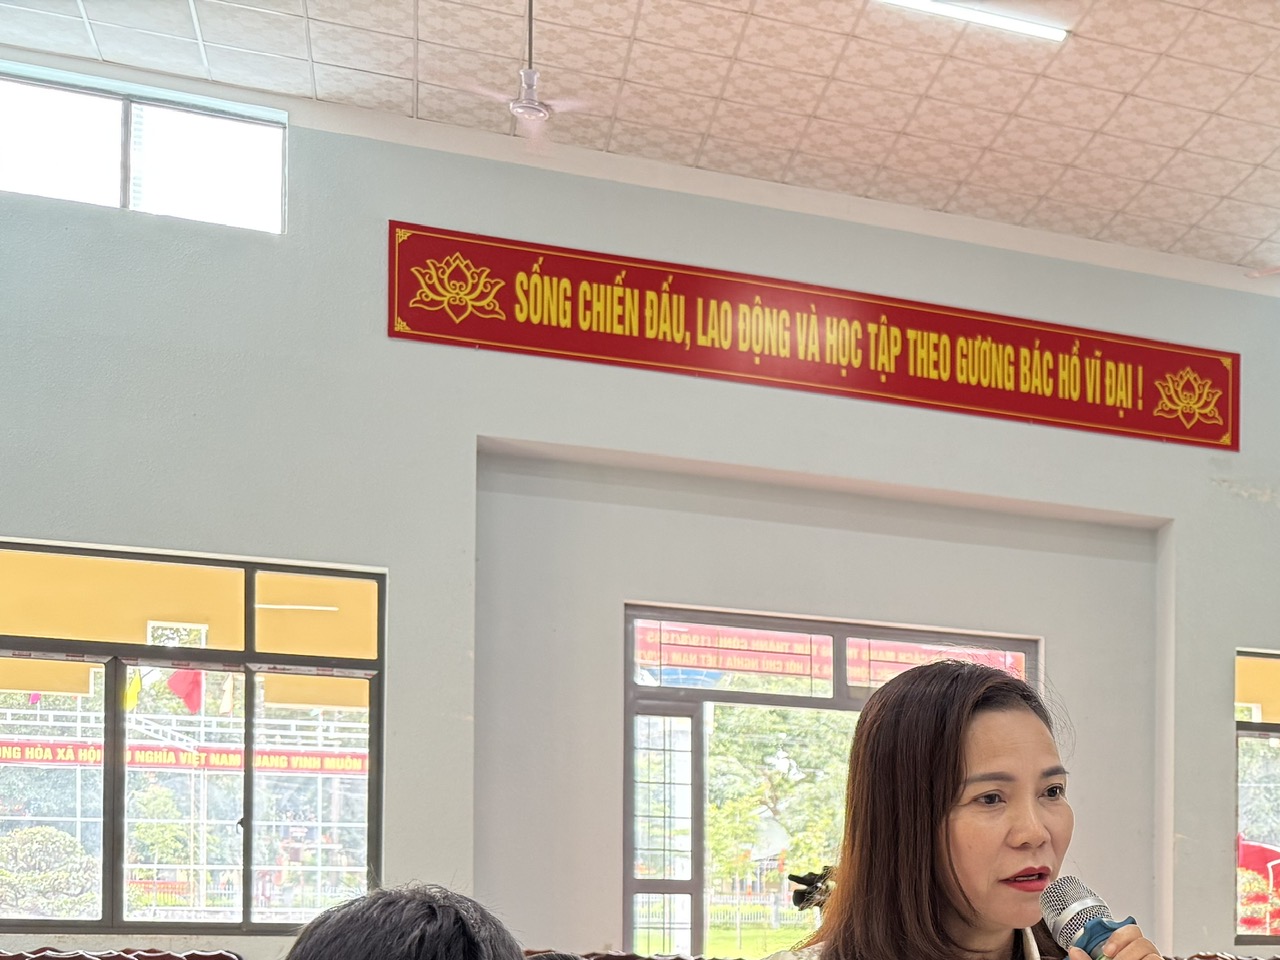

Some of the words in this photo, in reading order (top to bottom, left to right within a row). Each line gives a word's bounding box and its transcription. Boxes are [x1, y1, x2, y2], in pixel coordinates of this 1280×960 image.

[514, 257, 572, 328] SỐNG
[578, 270, 639, 338] CHIẾN
[645, 275, 691, 351] ĐẤU,
[697, 297, 732, 351] LAO
[738, 295, 791, 365] ĐỘNG
[796, 303, 820, 363] VÀ
[826, 315, 863, 377] HỌC
[868, 315, 901, 383] TẬP
[906, 328, 951, 383] THEO
[955, 334, 1015, 391] GƯƠNG
[1019, 338, 1054, 398] BÁC
[1058, 339, 1081, 402] HỒ
[1104, 362, 1133, 418] ĐẠI
[0, 746, 21, 759] NG
[57, 745, 75, 761] XÃ
[135, 749, 176, 764] NGHĨA
[209, 753, 241, 767] NAM
[291, 756, 321, 769] VINH
